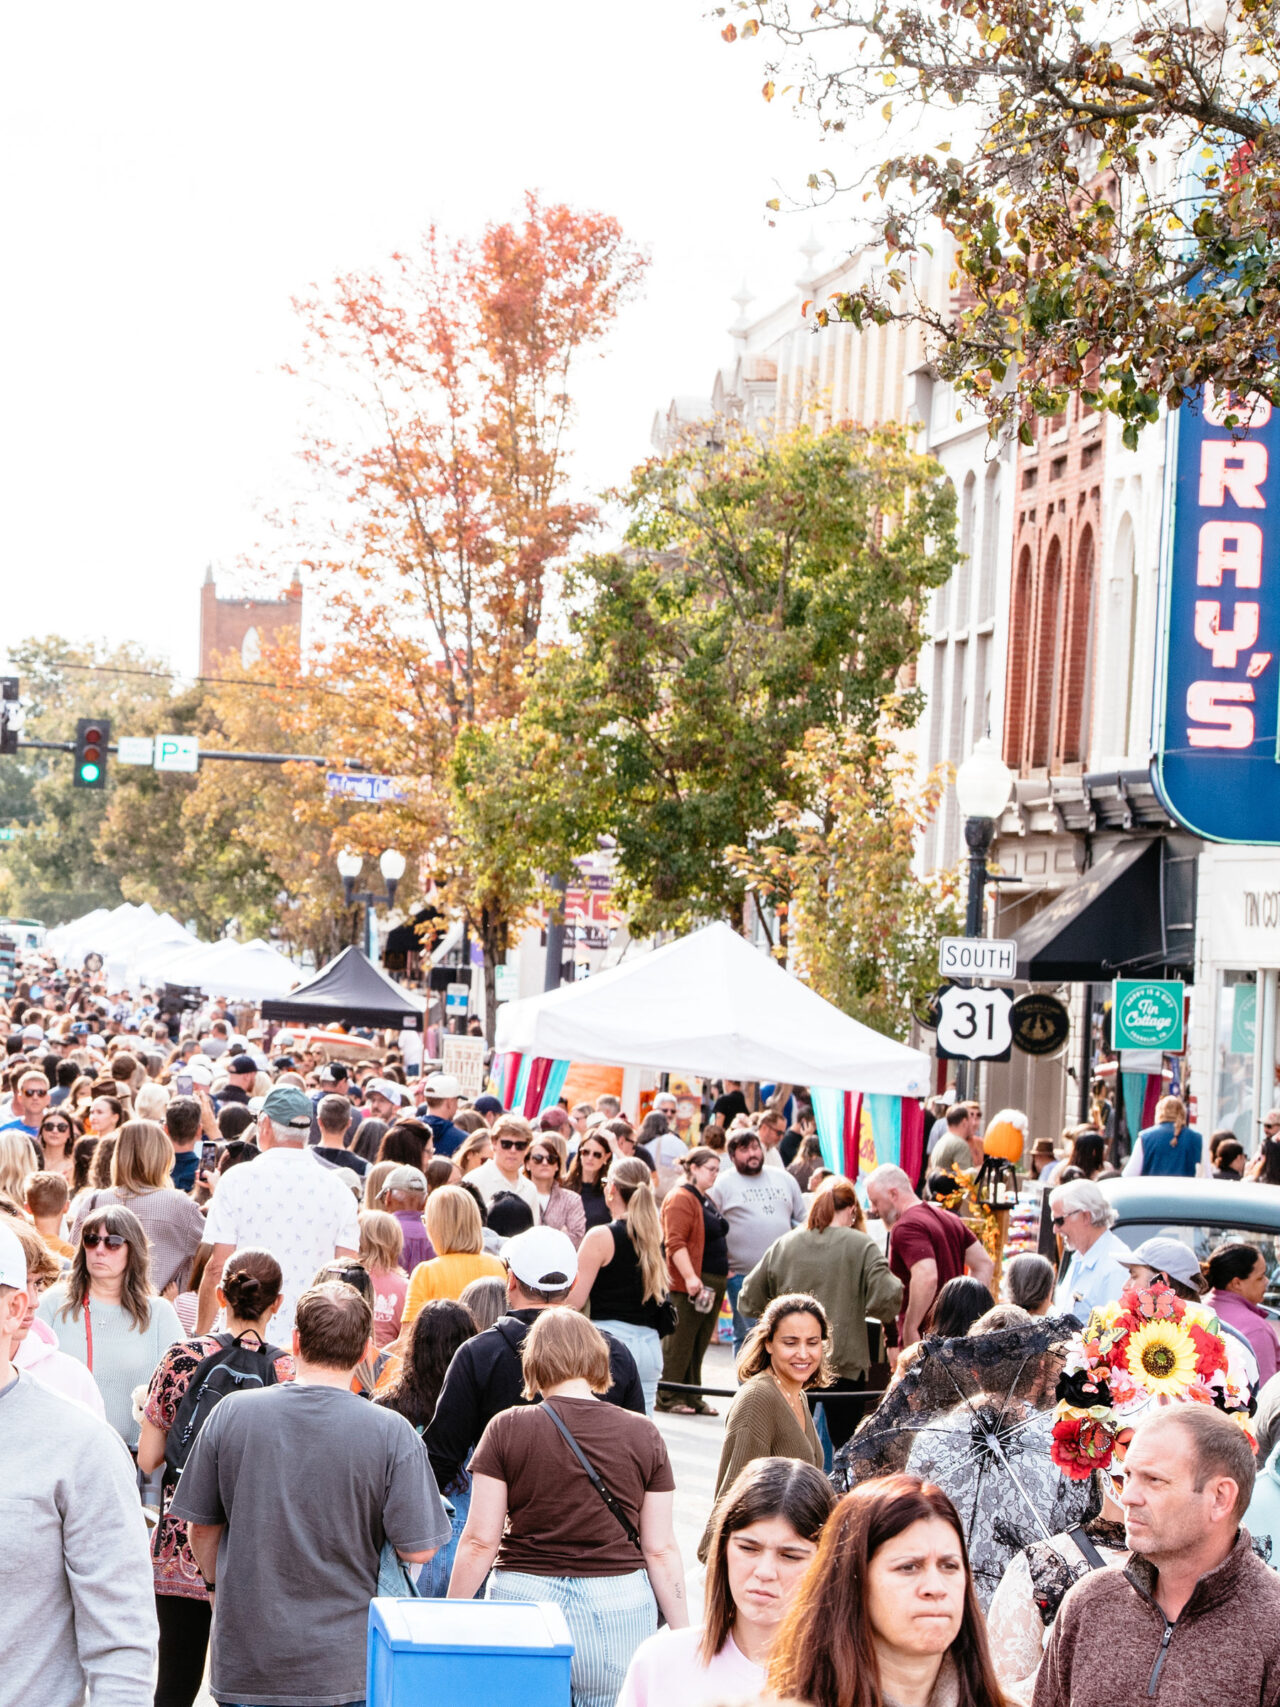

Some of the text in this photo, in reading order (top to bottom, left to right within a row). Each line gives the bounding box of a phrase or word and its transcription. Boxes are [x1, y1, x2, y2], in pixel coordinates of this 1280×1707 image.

[161, 742, 179, 762] P
[1263, 890, 1280, 928] CO
[946, 945, 1011, 969] SOUTH
[1138, 999, 1159, 1015] Tin
[953, 1002, 995, 1040] 31
[1125, 1010, 1172, 1031] Cottage
